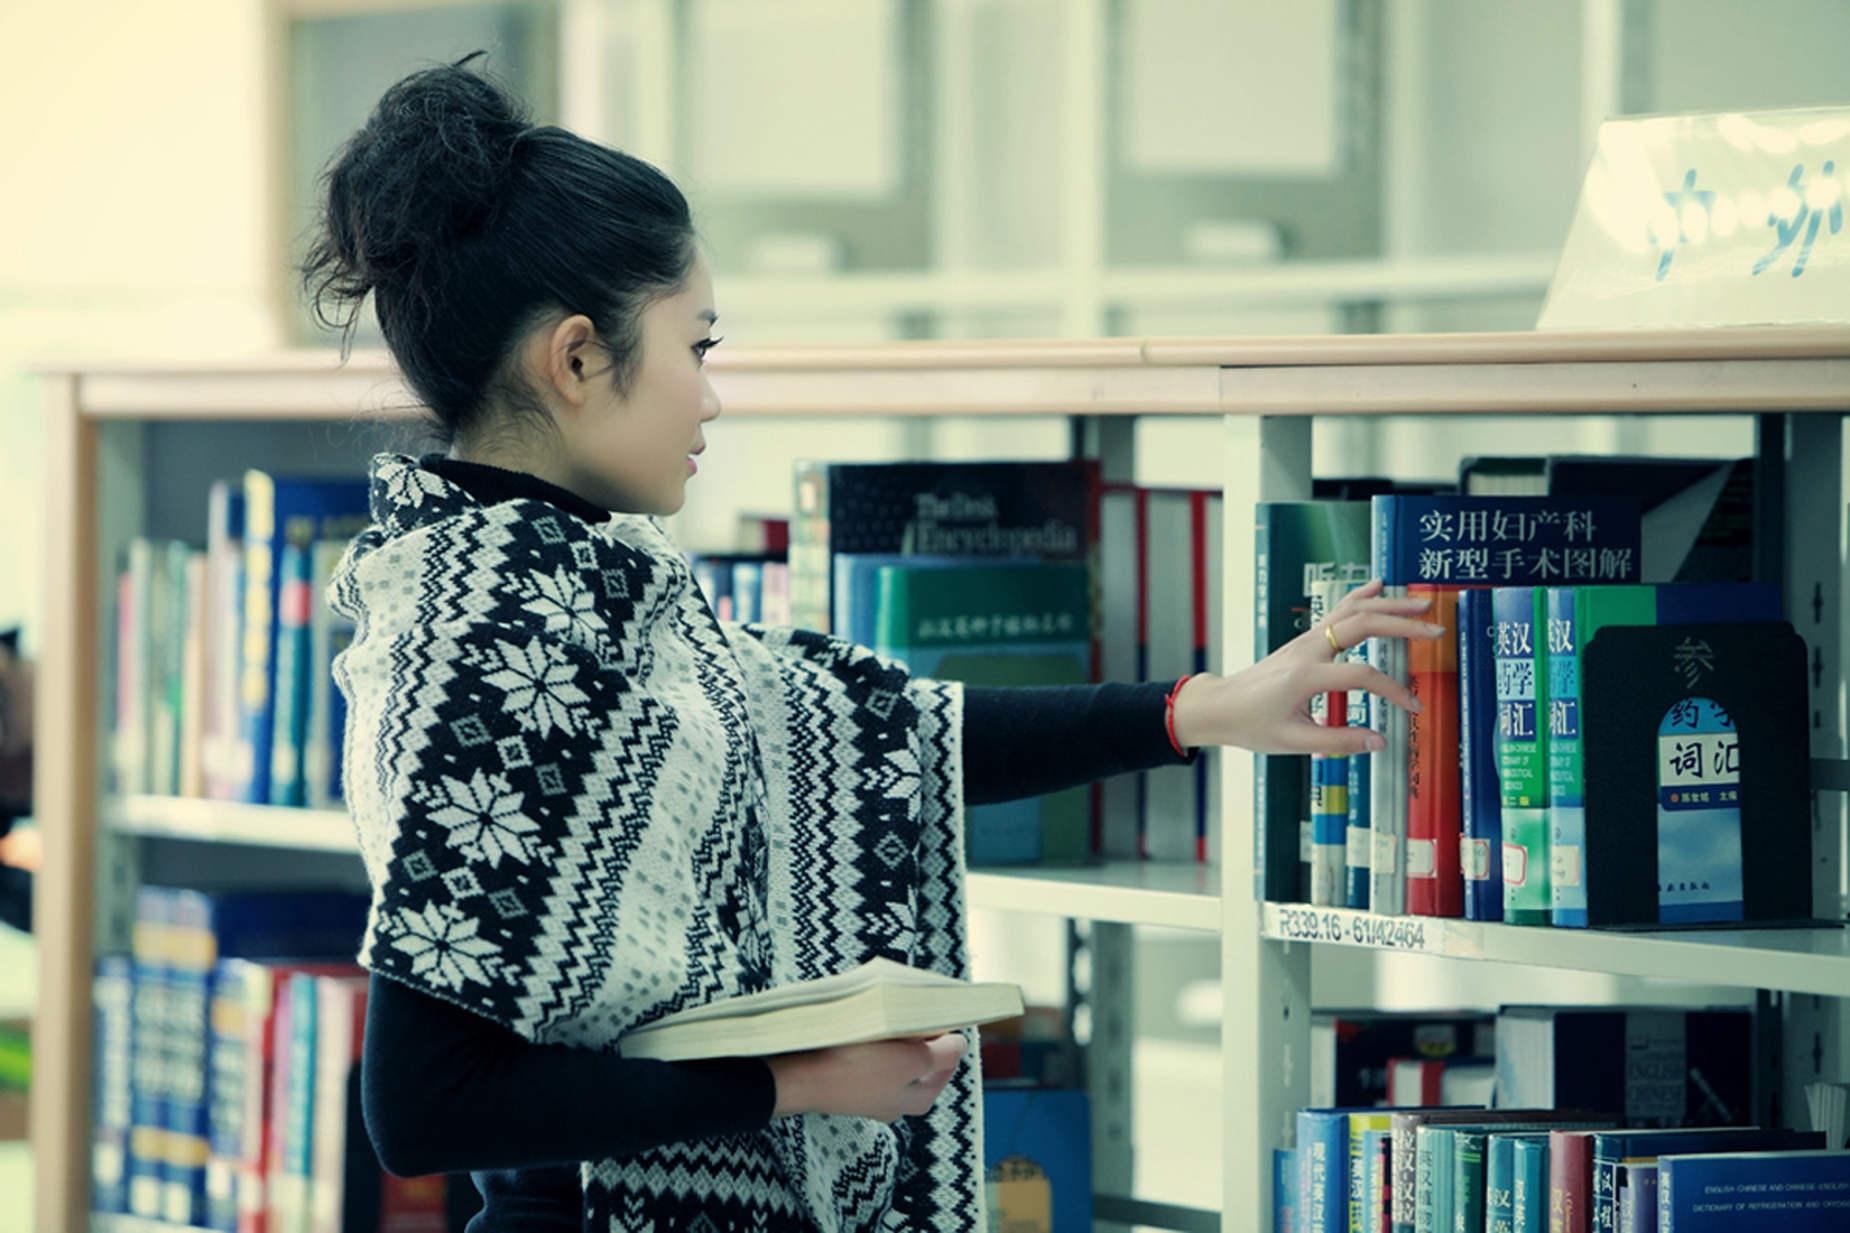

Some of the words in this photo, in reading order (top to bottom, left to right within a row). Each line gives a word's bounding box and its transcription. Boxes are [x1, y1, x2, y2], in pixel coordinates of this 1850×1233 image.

[917, 519, 1078, 553] Encyclopedia
[1419, 510, 1597, 543] 实用妇产科
[1418, 547, 1633, 580] 新型手术图解
[1496, 621, 1533, 656] 英汉
[1673, 636, 1714, 690] 参
[1669, 740, 1740, 779] 词汇
[1768, 1183, 1784, 1193] AND
[1692, 1203, 1733, 1214] DICTIONARY
[1735, 1202, 1746, 1212] OF
[1748, 1201, 1803, 1211] REFRIGERATION
[1805, 1201, 1820, 1209] AND
